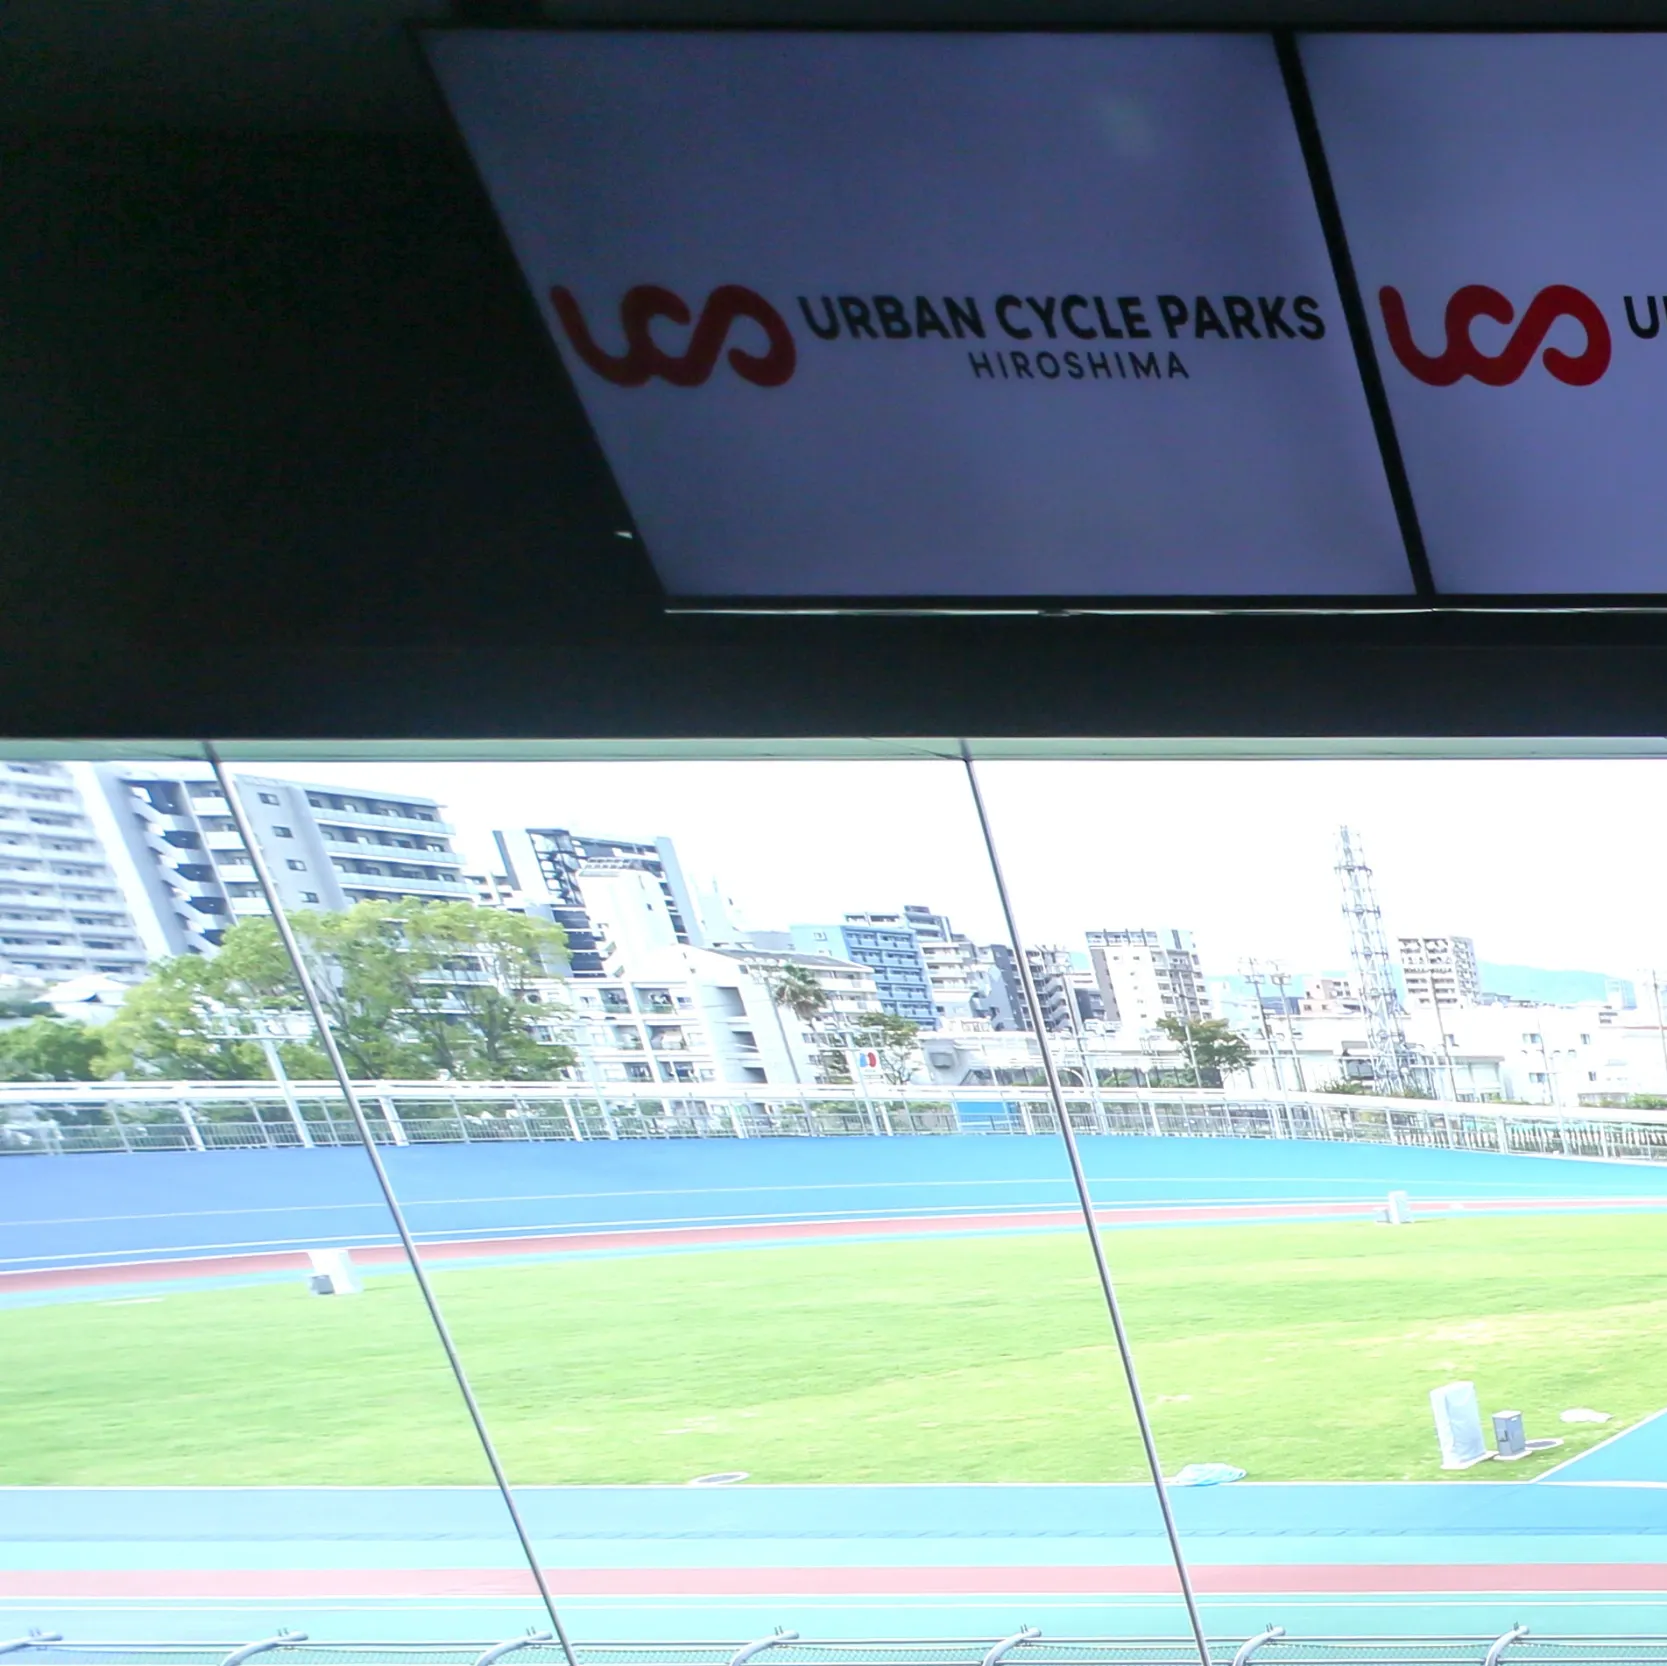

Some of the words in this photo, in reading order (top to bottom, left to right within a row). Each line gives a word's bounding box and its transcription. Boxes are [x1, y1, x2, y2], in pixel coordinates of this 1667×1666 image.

[797, 294, 987, 340] URBAN
[995, 294, 1150, 340] CYCLE
[1157, 294, 1327, 340] PARKS
[968, 350, 1190, 380] HIROSHIMA
